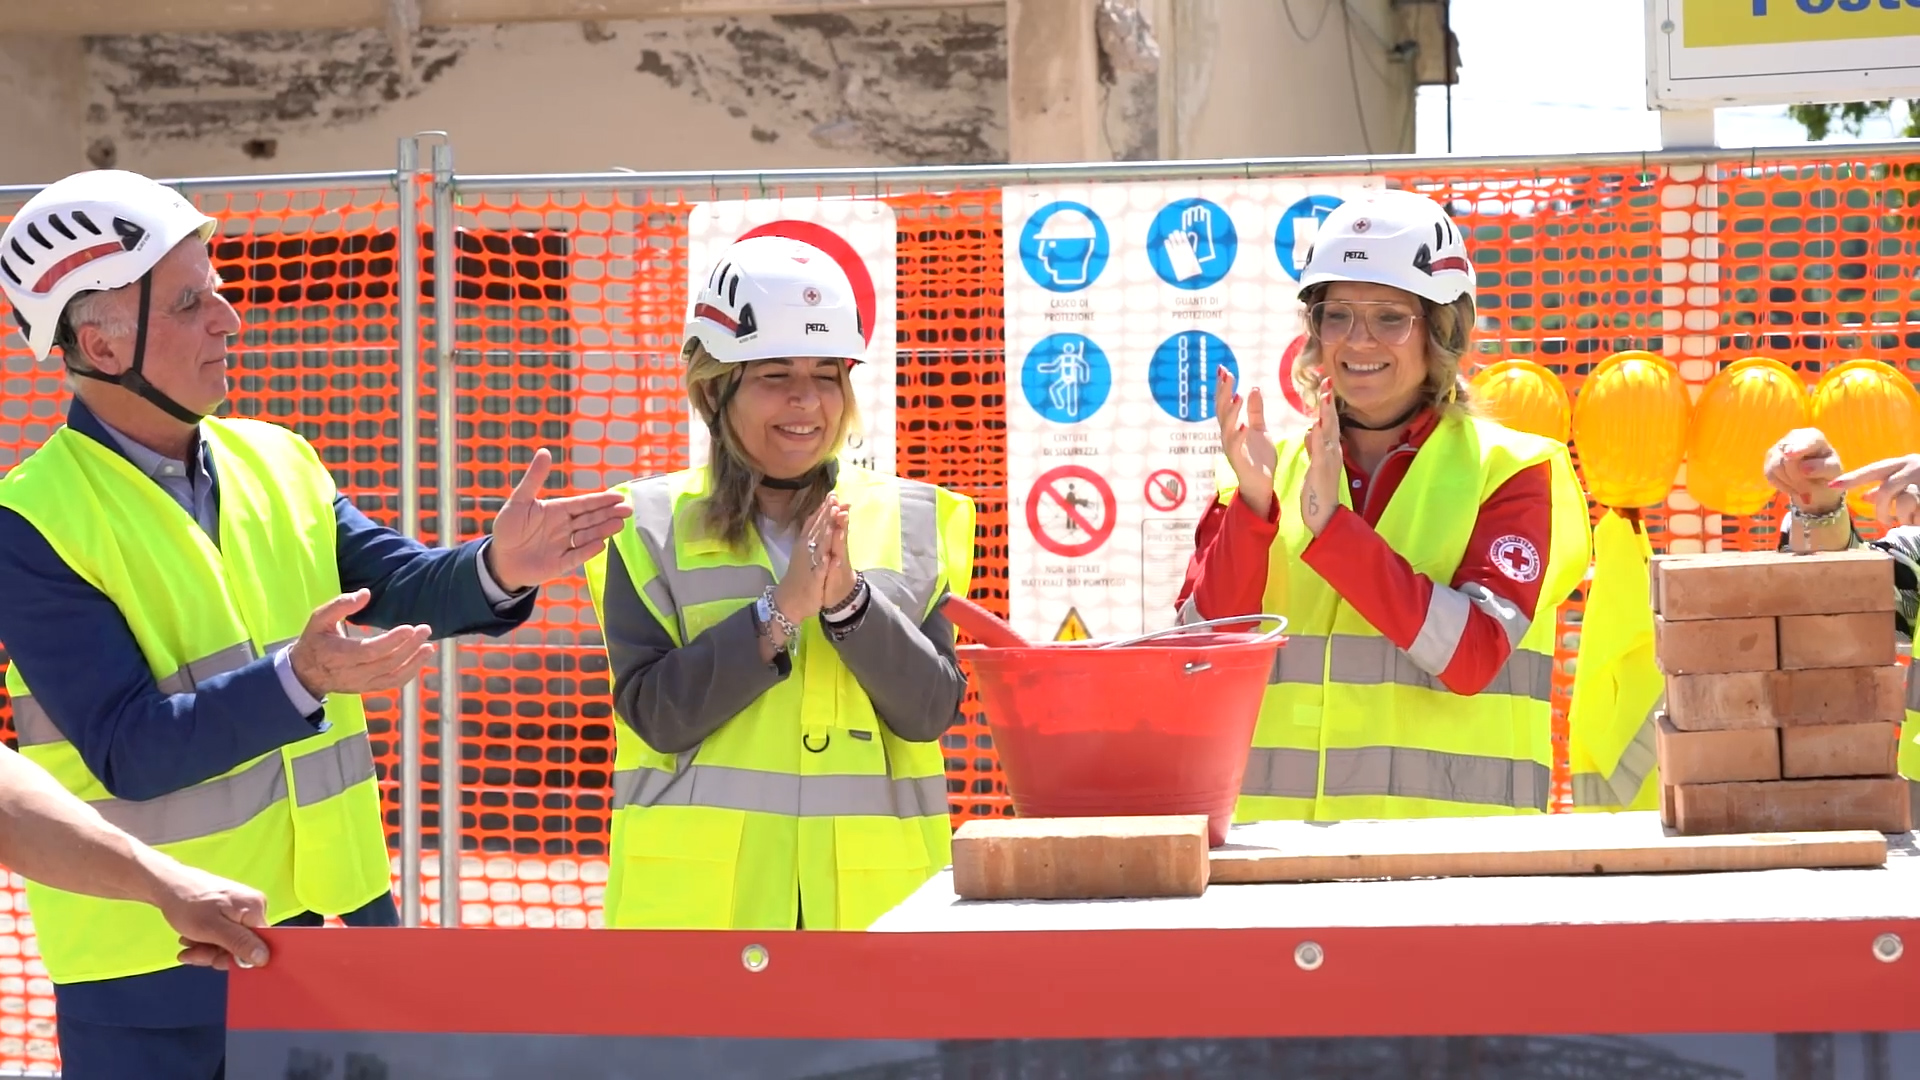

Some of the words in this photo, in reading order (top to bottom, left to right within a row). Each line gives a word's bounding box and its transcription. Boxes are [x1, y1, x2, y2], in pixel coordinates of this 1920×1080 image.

[1343, 250, 1369, 263] PETZL
[1050, 298, 1077, 309] CASCO
[1079, 298, 1089, 309] DI
[1175, 296, 1207, 306] GUANTI
[1209, 296, 1219, 305] DI
[1044, 311, 1095, 321] PROTEZIONE
[1172, 310, 1223, 320] PROTEZIONE
[805, 322, 830, 336] PETZL
[1055, 446, 1100, 456] SICUREZZA
